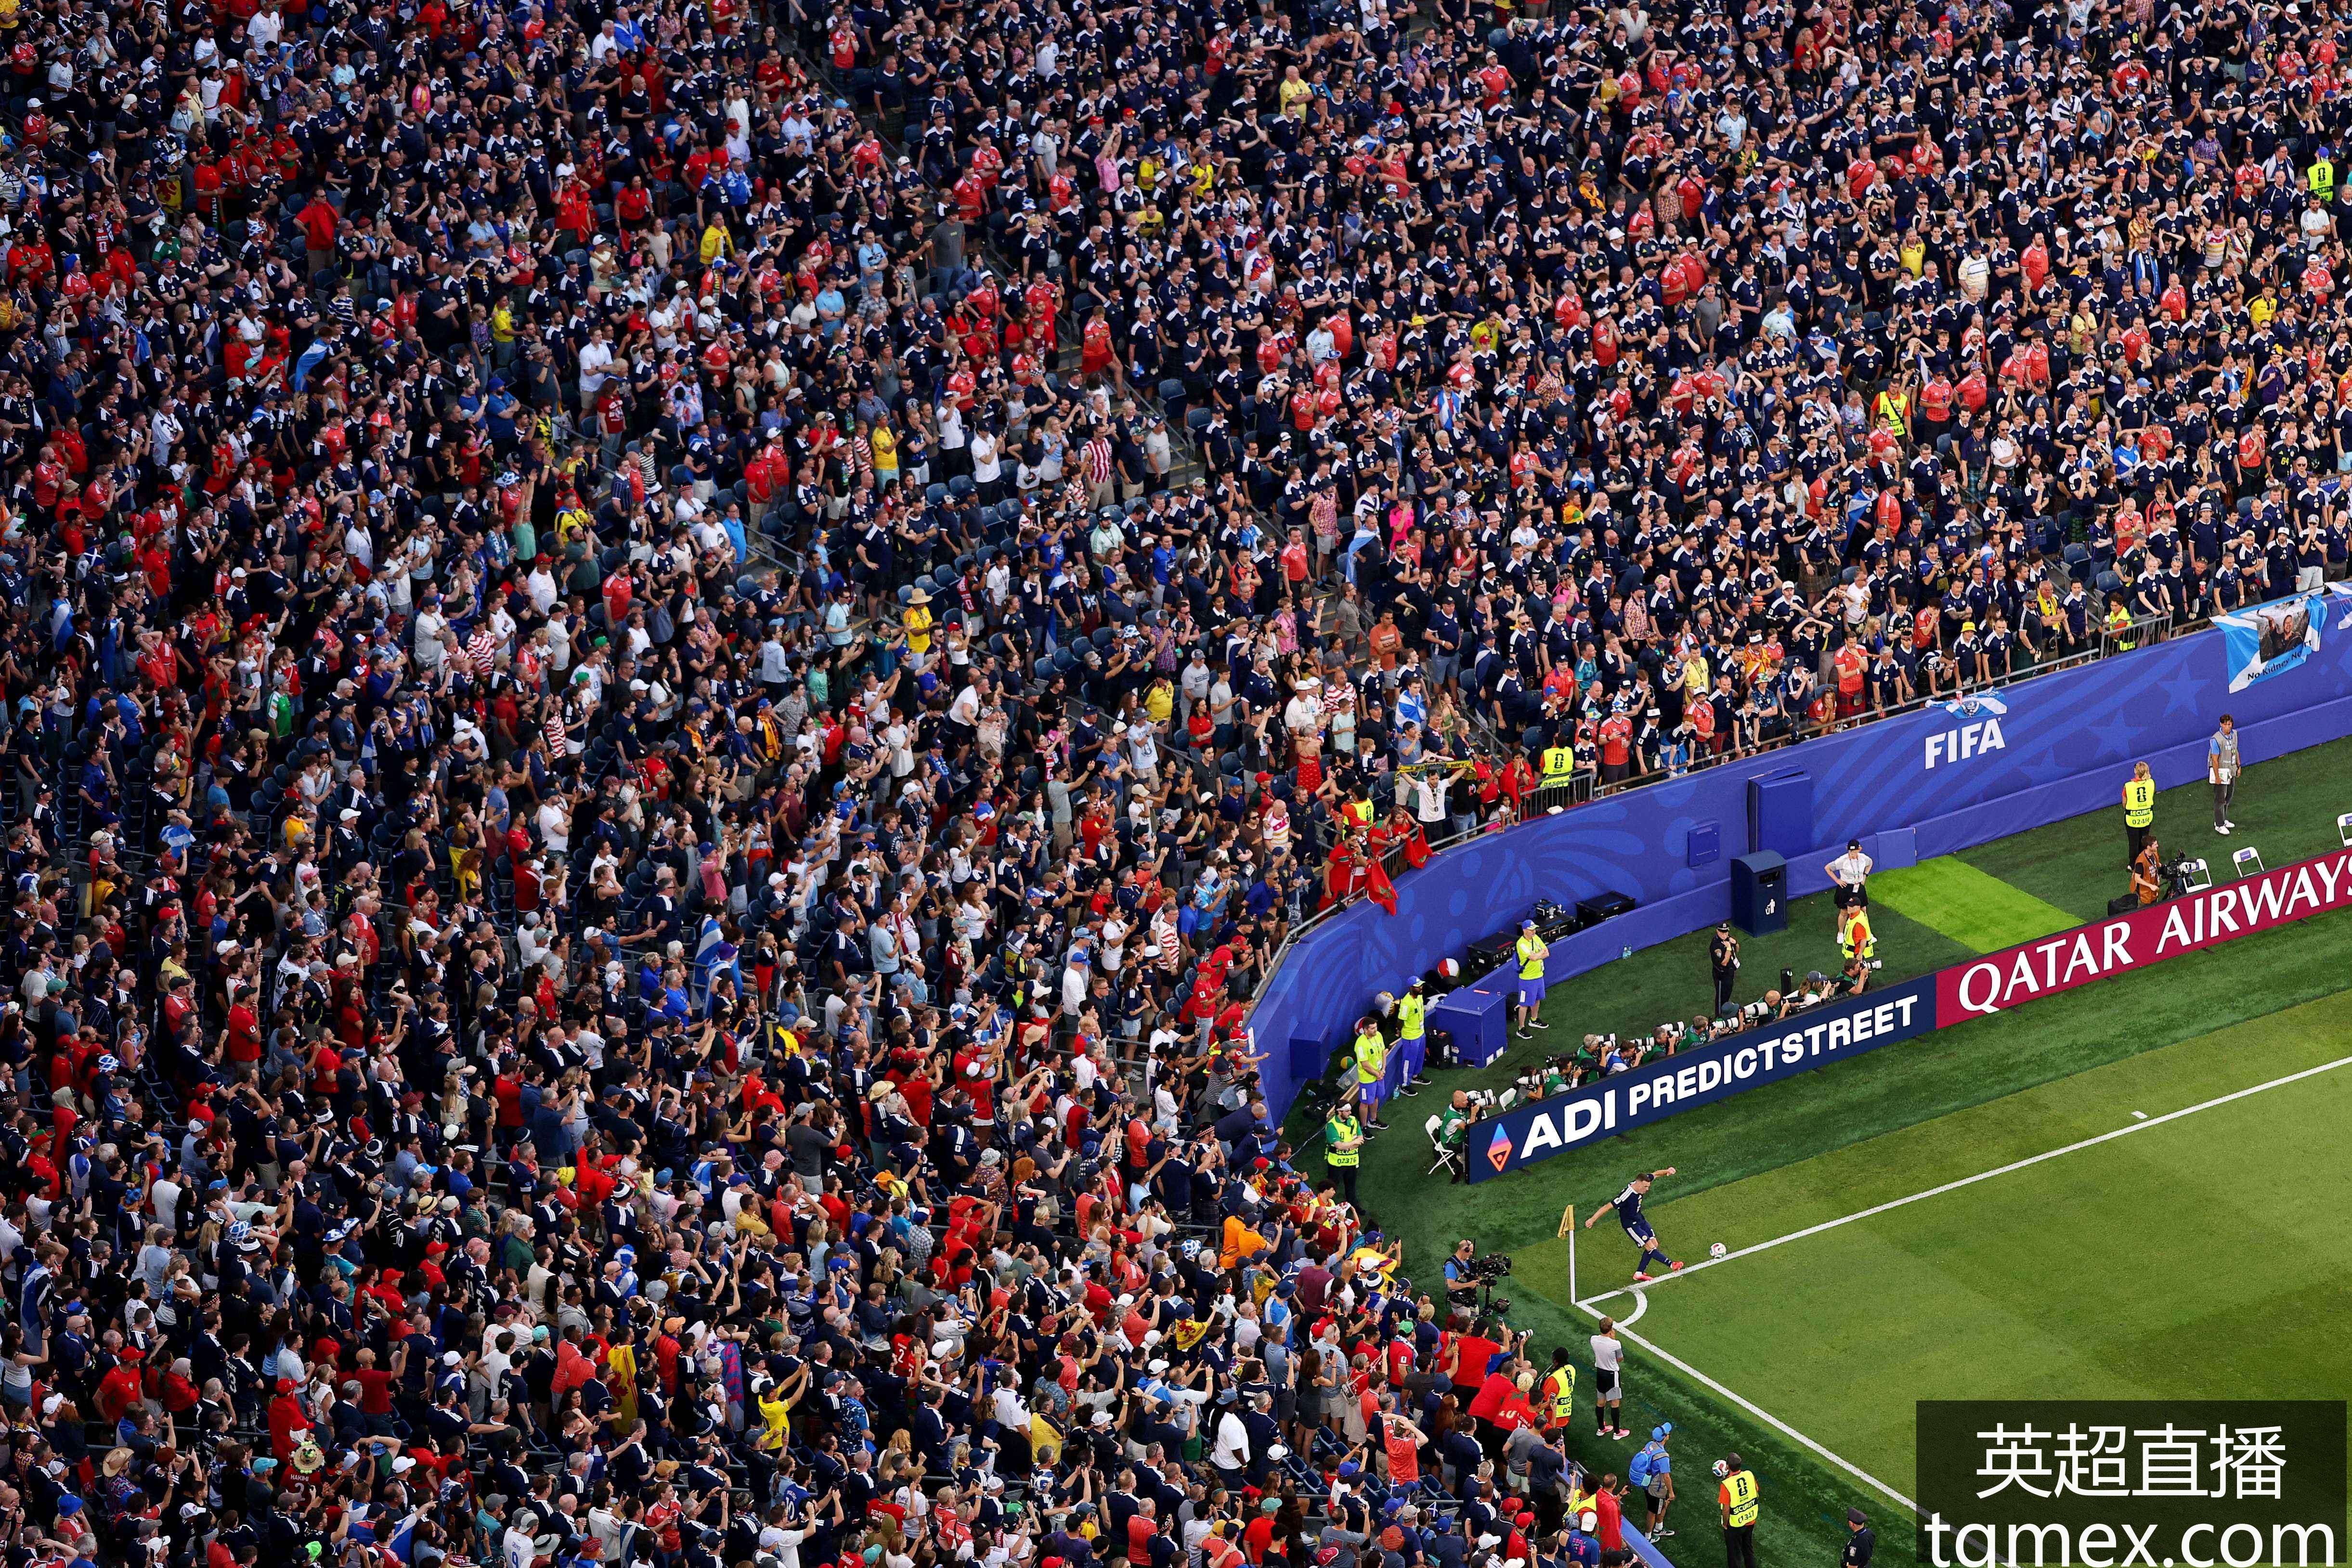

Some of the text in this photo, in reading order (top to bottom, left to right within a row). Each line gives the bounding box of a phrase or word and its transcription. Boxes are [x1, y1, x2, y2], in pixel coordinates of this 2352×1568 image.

[2281, 457, 2289, 466] 64
[2248, 672, 2260, 680] No
[2262, 658, 2289, 675] Kidney
[1925, 717, 2006, 770] FIFA
[1960, 852, 2352, 1013] QATAR AIRWAY
[1520, 995, 1918, 1159] ADI PREDICTSTREET
[897, 1348, 905, 1363] 2
[871, 1509, 890, 1517] ASHRA
[1733, 1499, 1755, 1515] SECURITY
